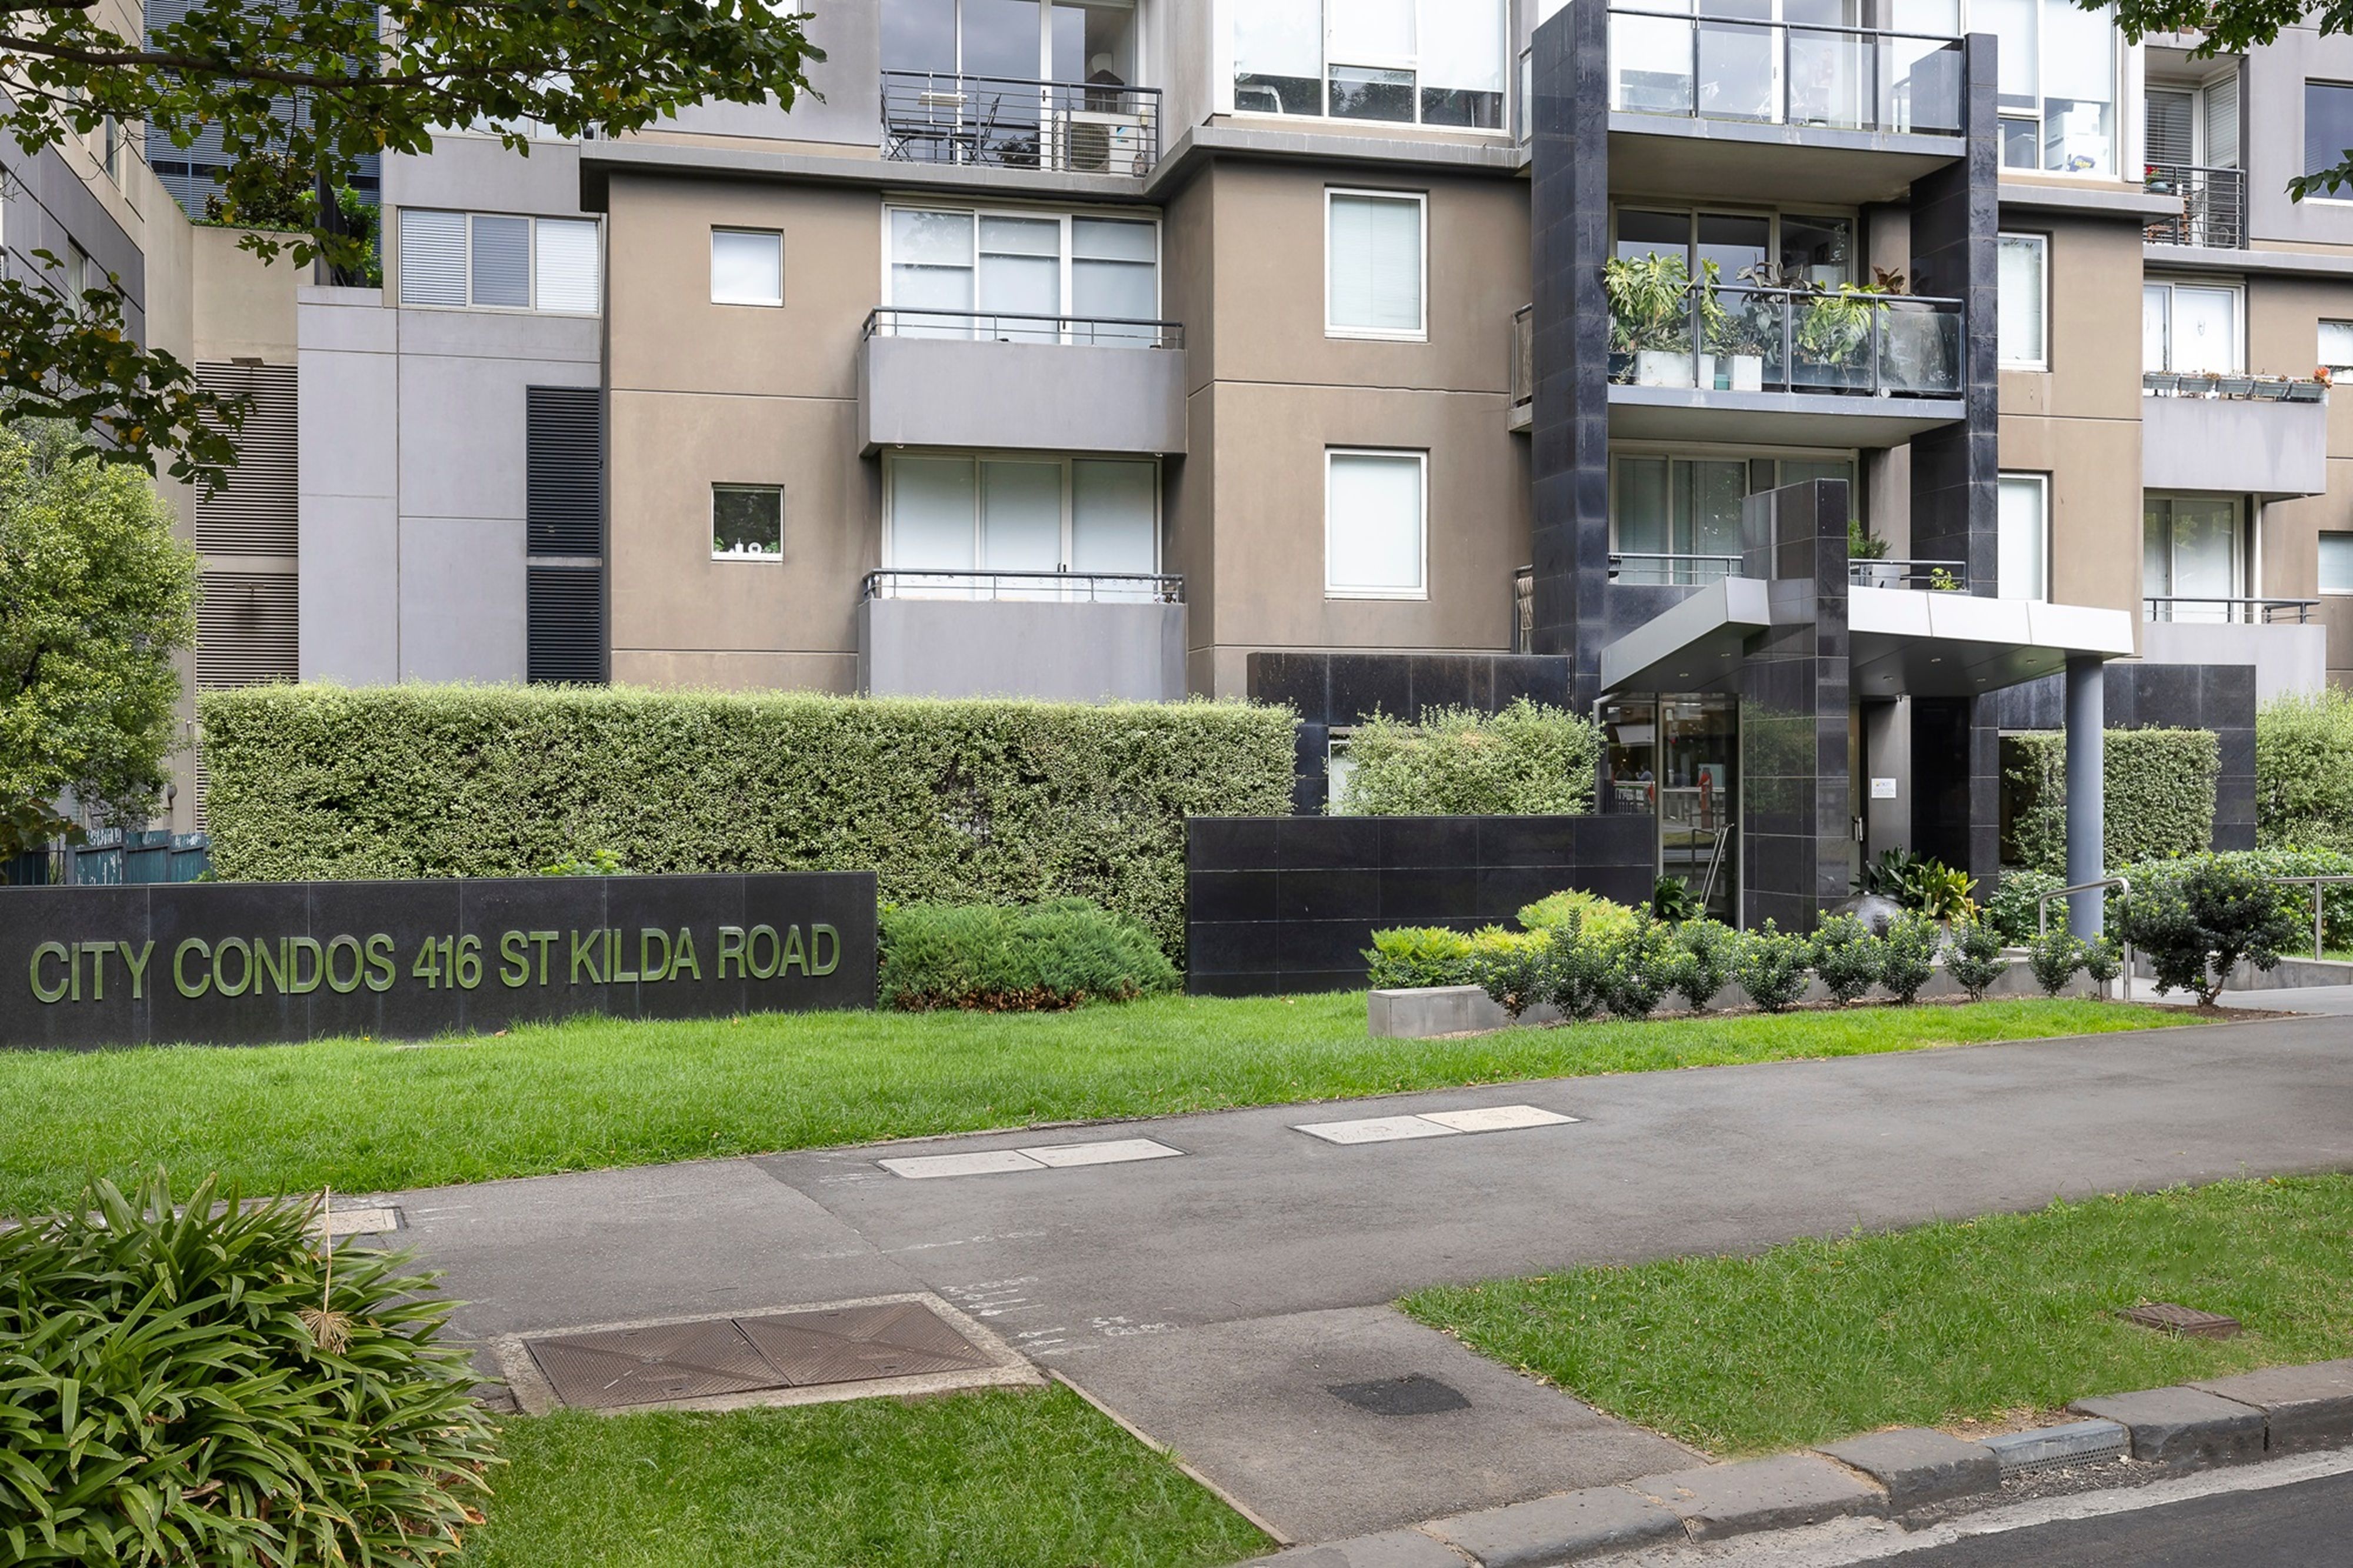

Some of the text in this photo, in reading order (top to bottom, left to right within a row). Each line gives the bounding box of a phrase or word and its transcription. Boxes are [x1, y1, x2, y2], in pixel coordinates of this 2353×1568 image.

[30, 924, 841, 1002] CITY CONDOS 416 ST KILDA ROAD
